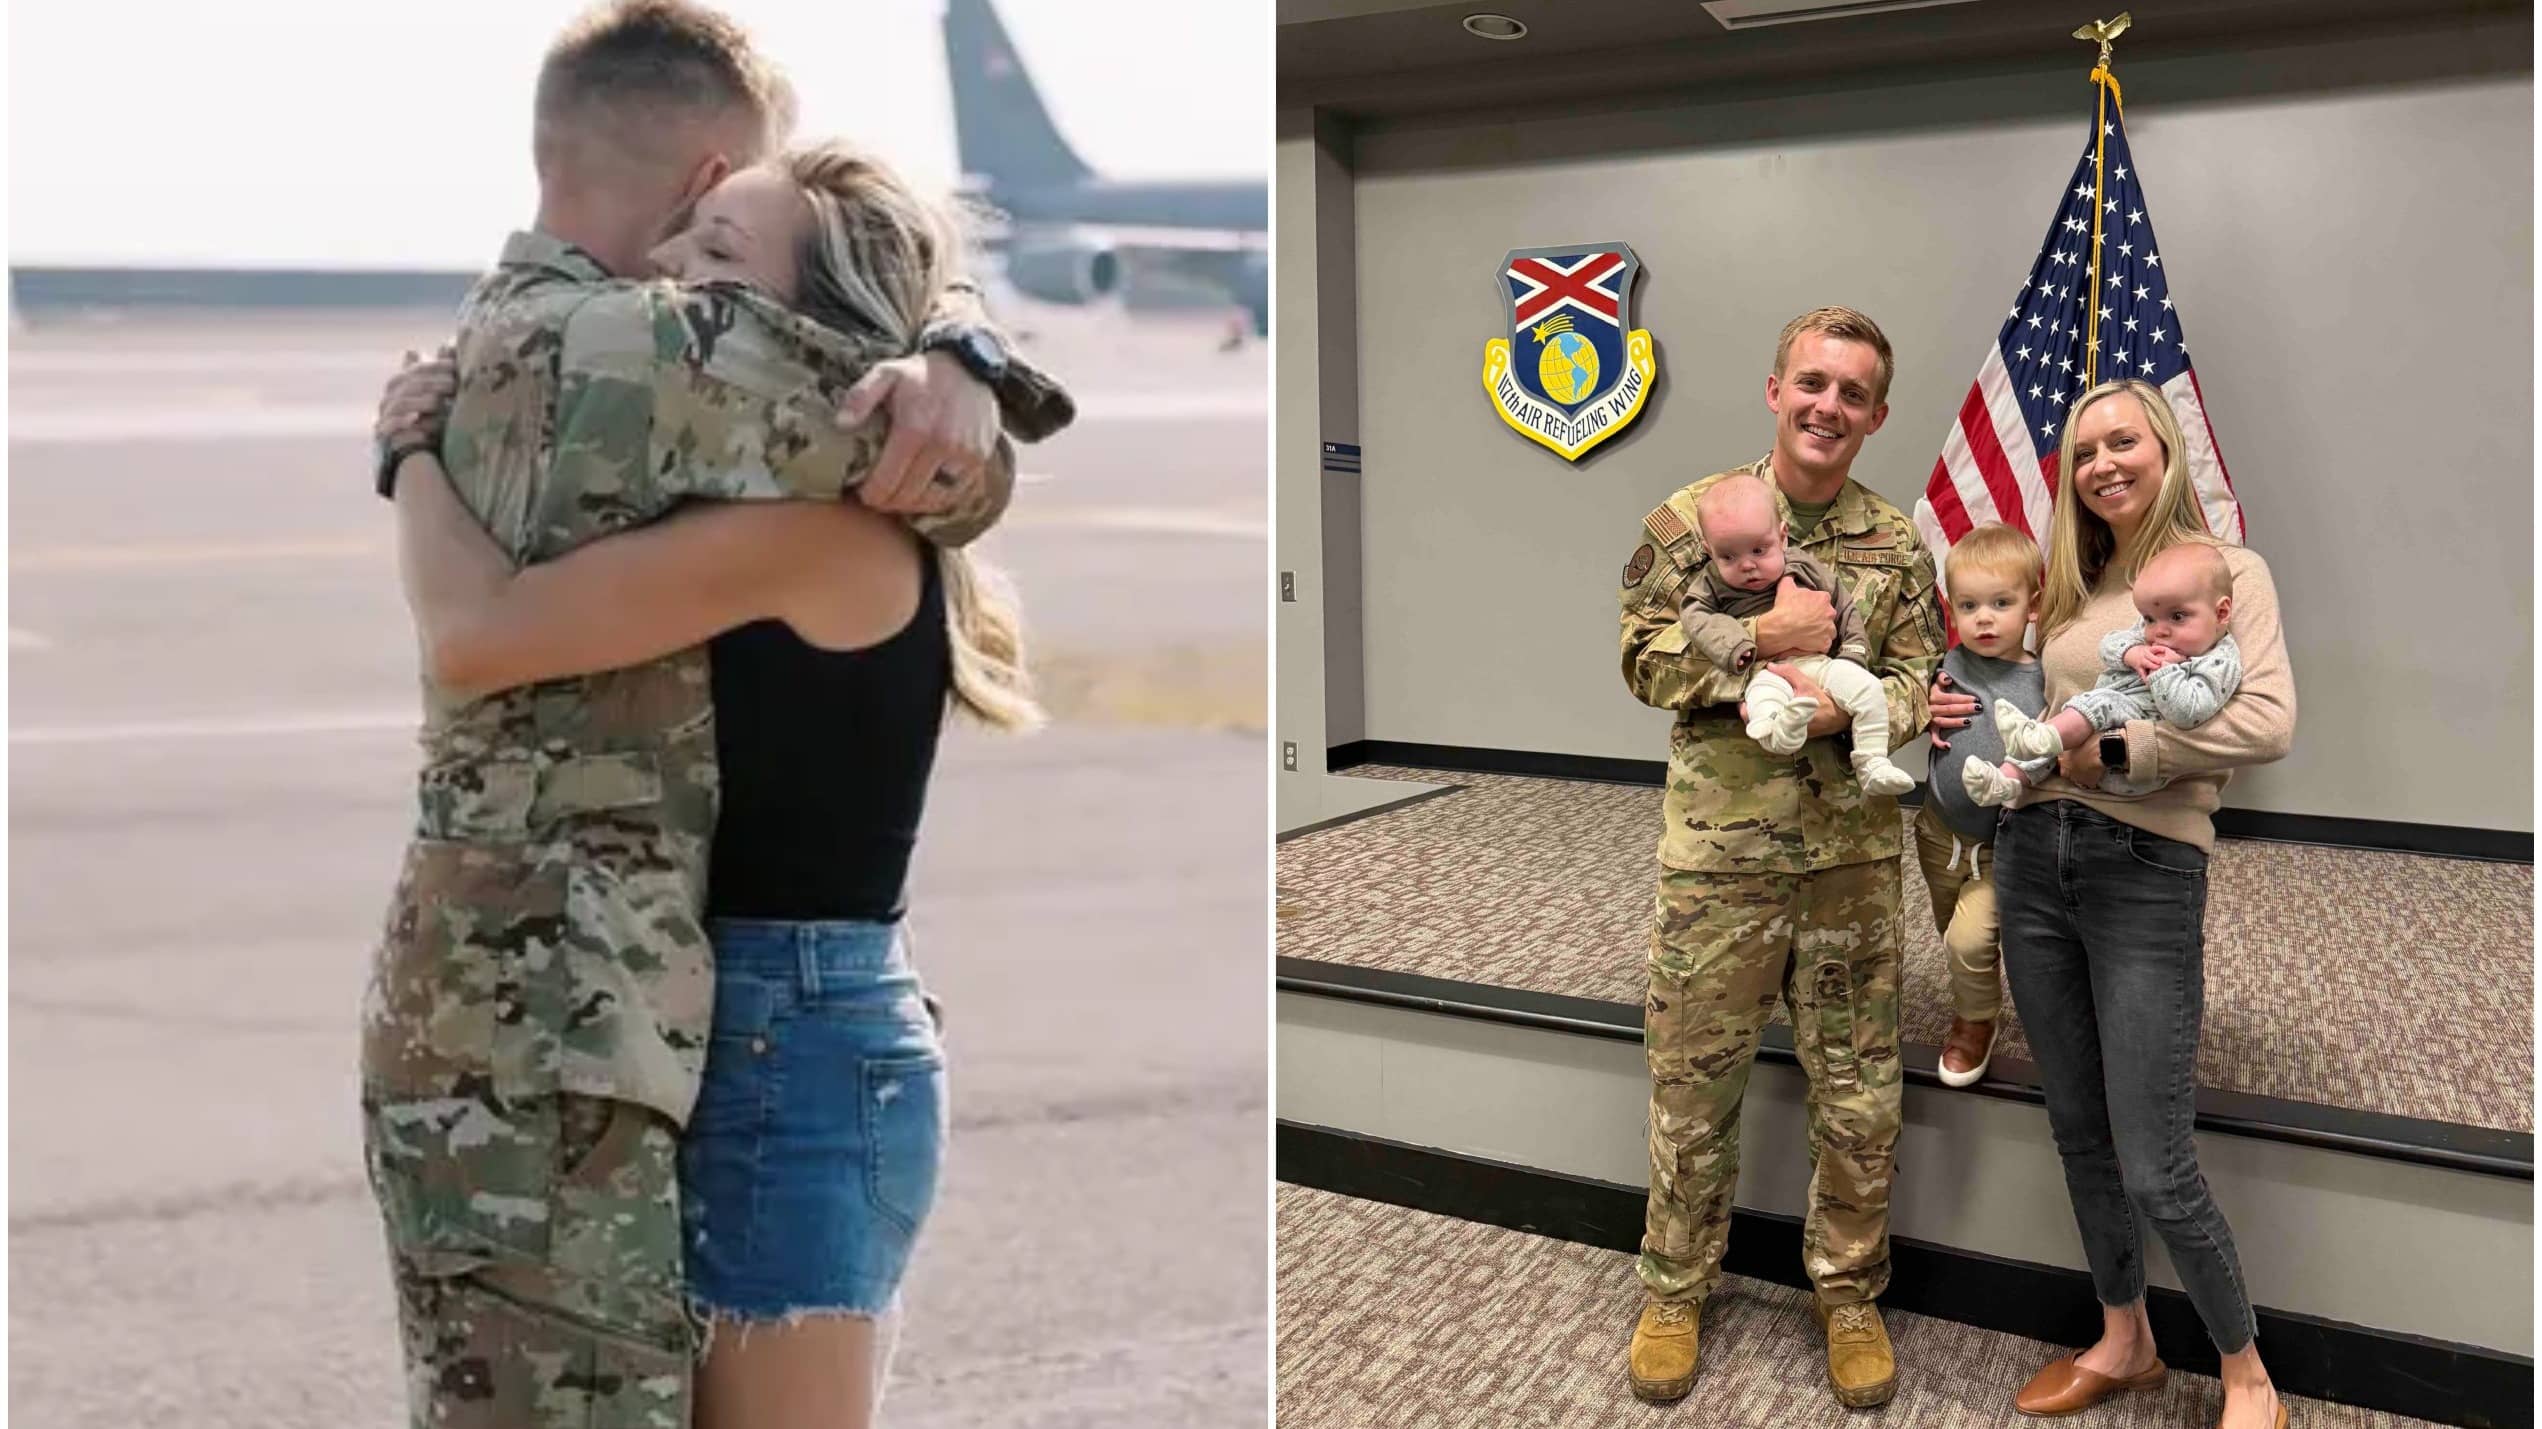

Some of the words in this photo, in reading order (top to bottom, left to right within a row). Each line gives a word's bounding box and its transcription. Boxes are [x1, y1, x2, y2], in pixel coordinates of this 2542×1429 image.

[1497, 373, 1519, 413] 117th
[1516, 403, 1542, 430] AIR
[1544, 407, 1608, 446] REFUELING
[1608, 368, 1642, 417] WING
